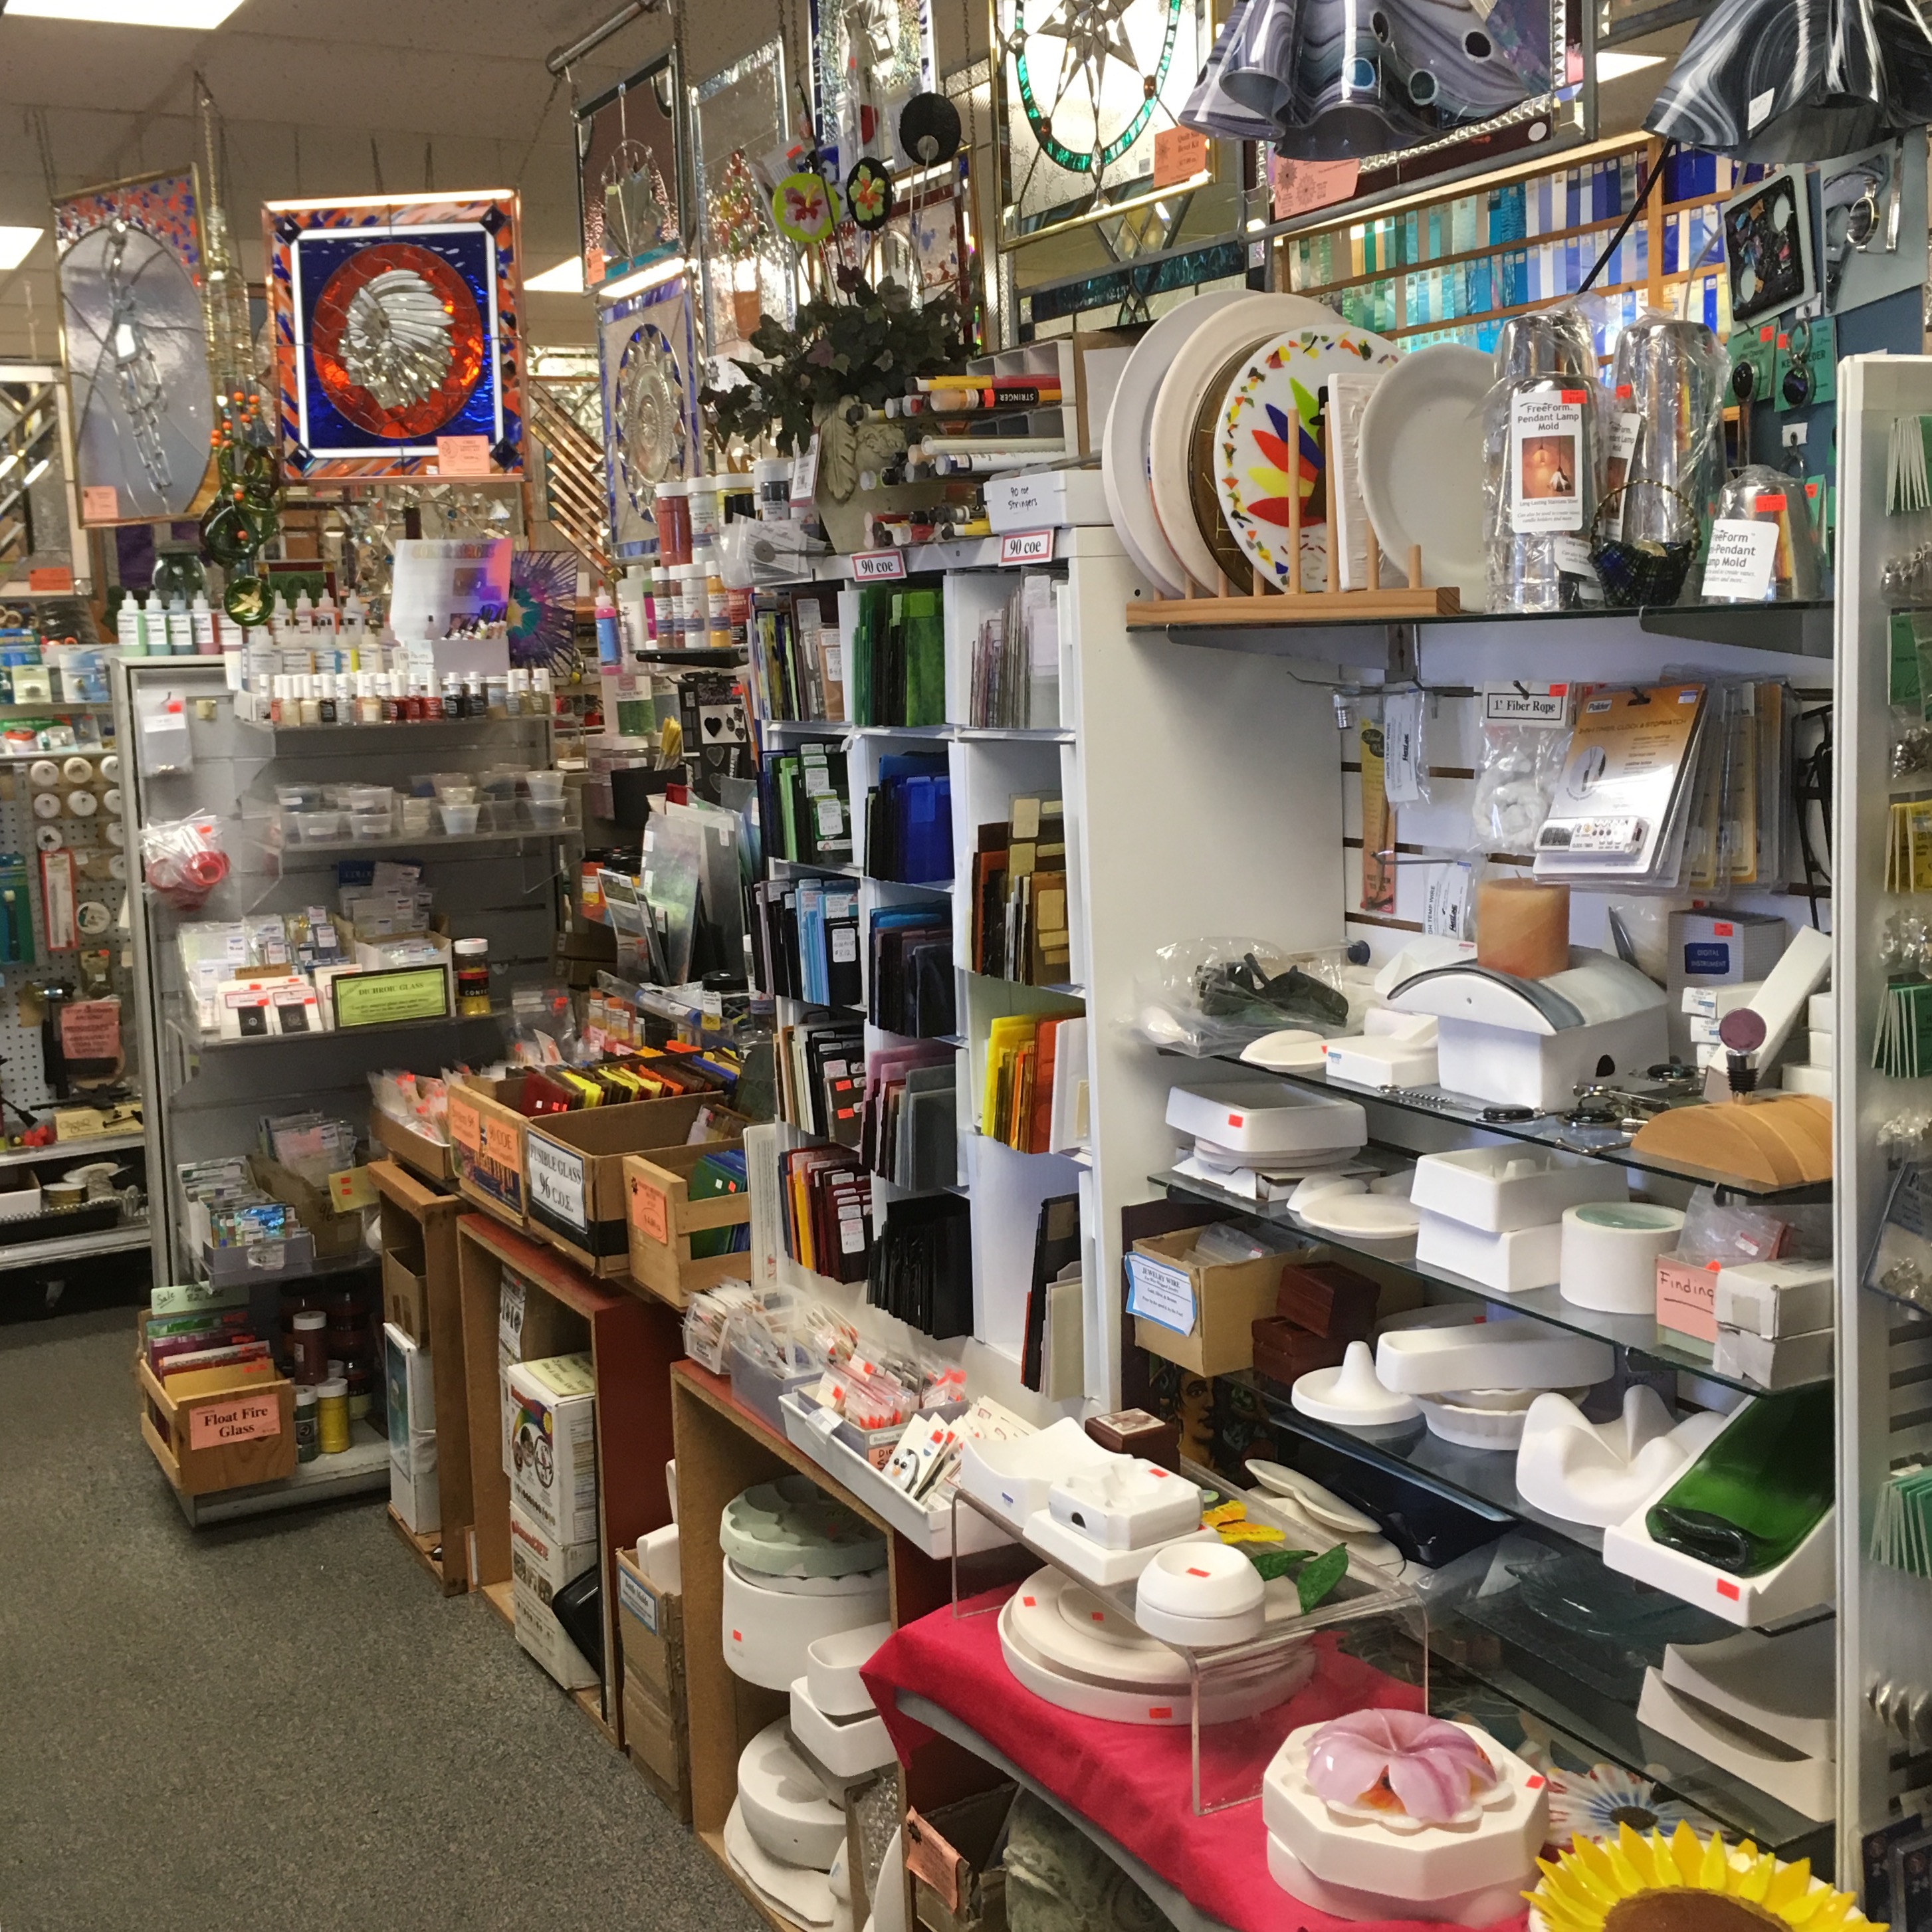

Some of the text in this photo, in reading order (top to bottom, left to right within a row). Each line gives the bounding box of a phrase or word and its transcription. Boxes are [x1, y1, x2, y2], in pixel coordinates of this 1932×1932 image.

[1000, 393, 1034, 401] STRINGER
[1527, 403, 1570, 413] FreeForm
[1517, 413, 1579, 423] Pendant Lamp
[1538, 422, 1560, 431] Mold
[1010, 486, 1019, 497] 90
[1010, 539, 1041, 556] 90 coe
[861, 559, 894, 575] 90 coe
[1708, 557, 1747, 568] amp Mold
[1494, 700, 1556, 714] 1' Fiber Rope
[1587, 700, 1611, 712] Polder
[1645, 718, 1687, 728] STOPWATCH
[358, 986, 397, 996] DICHROIC
[399, 982, 425, 992] GLASS
[530, 1143, 557, 1172] FUSIBLE
[558, 1160, 582, 1185] GLASS
[539, 1172, 574, 1213] 96 C.O.E.
[319, 1202, 334, 1222] 96
[1142, 1267, 1180, 1289] JEWELRY WIRE
[1660, 1270, 1714, 1306] Finding
[204, 1412, 238, 1426] Float
[242, 1407, 268, 1420] Fire
[219, 1424, 255, 1438] Glass
